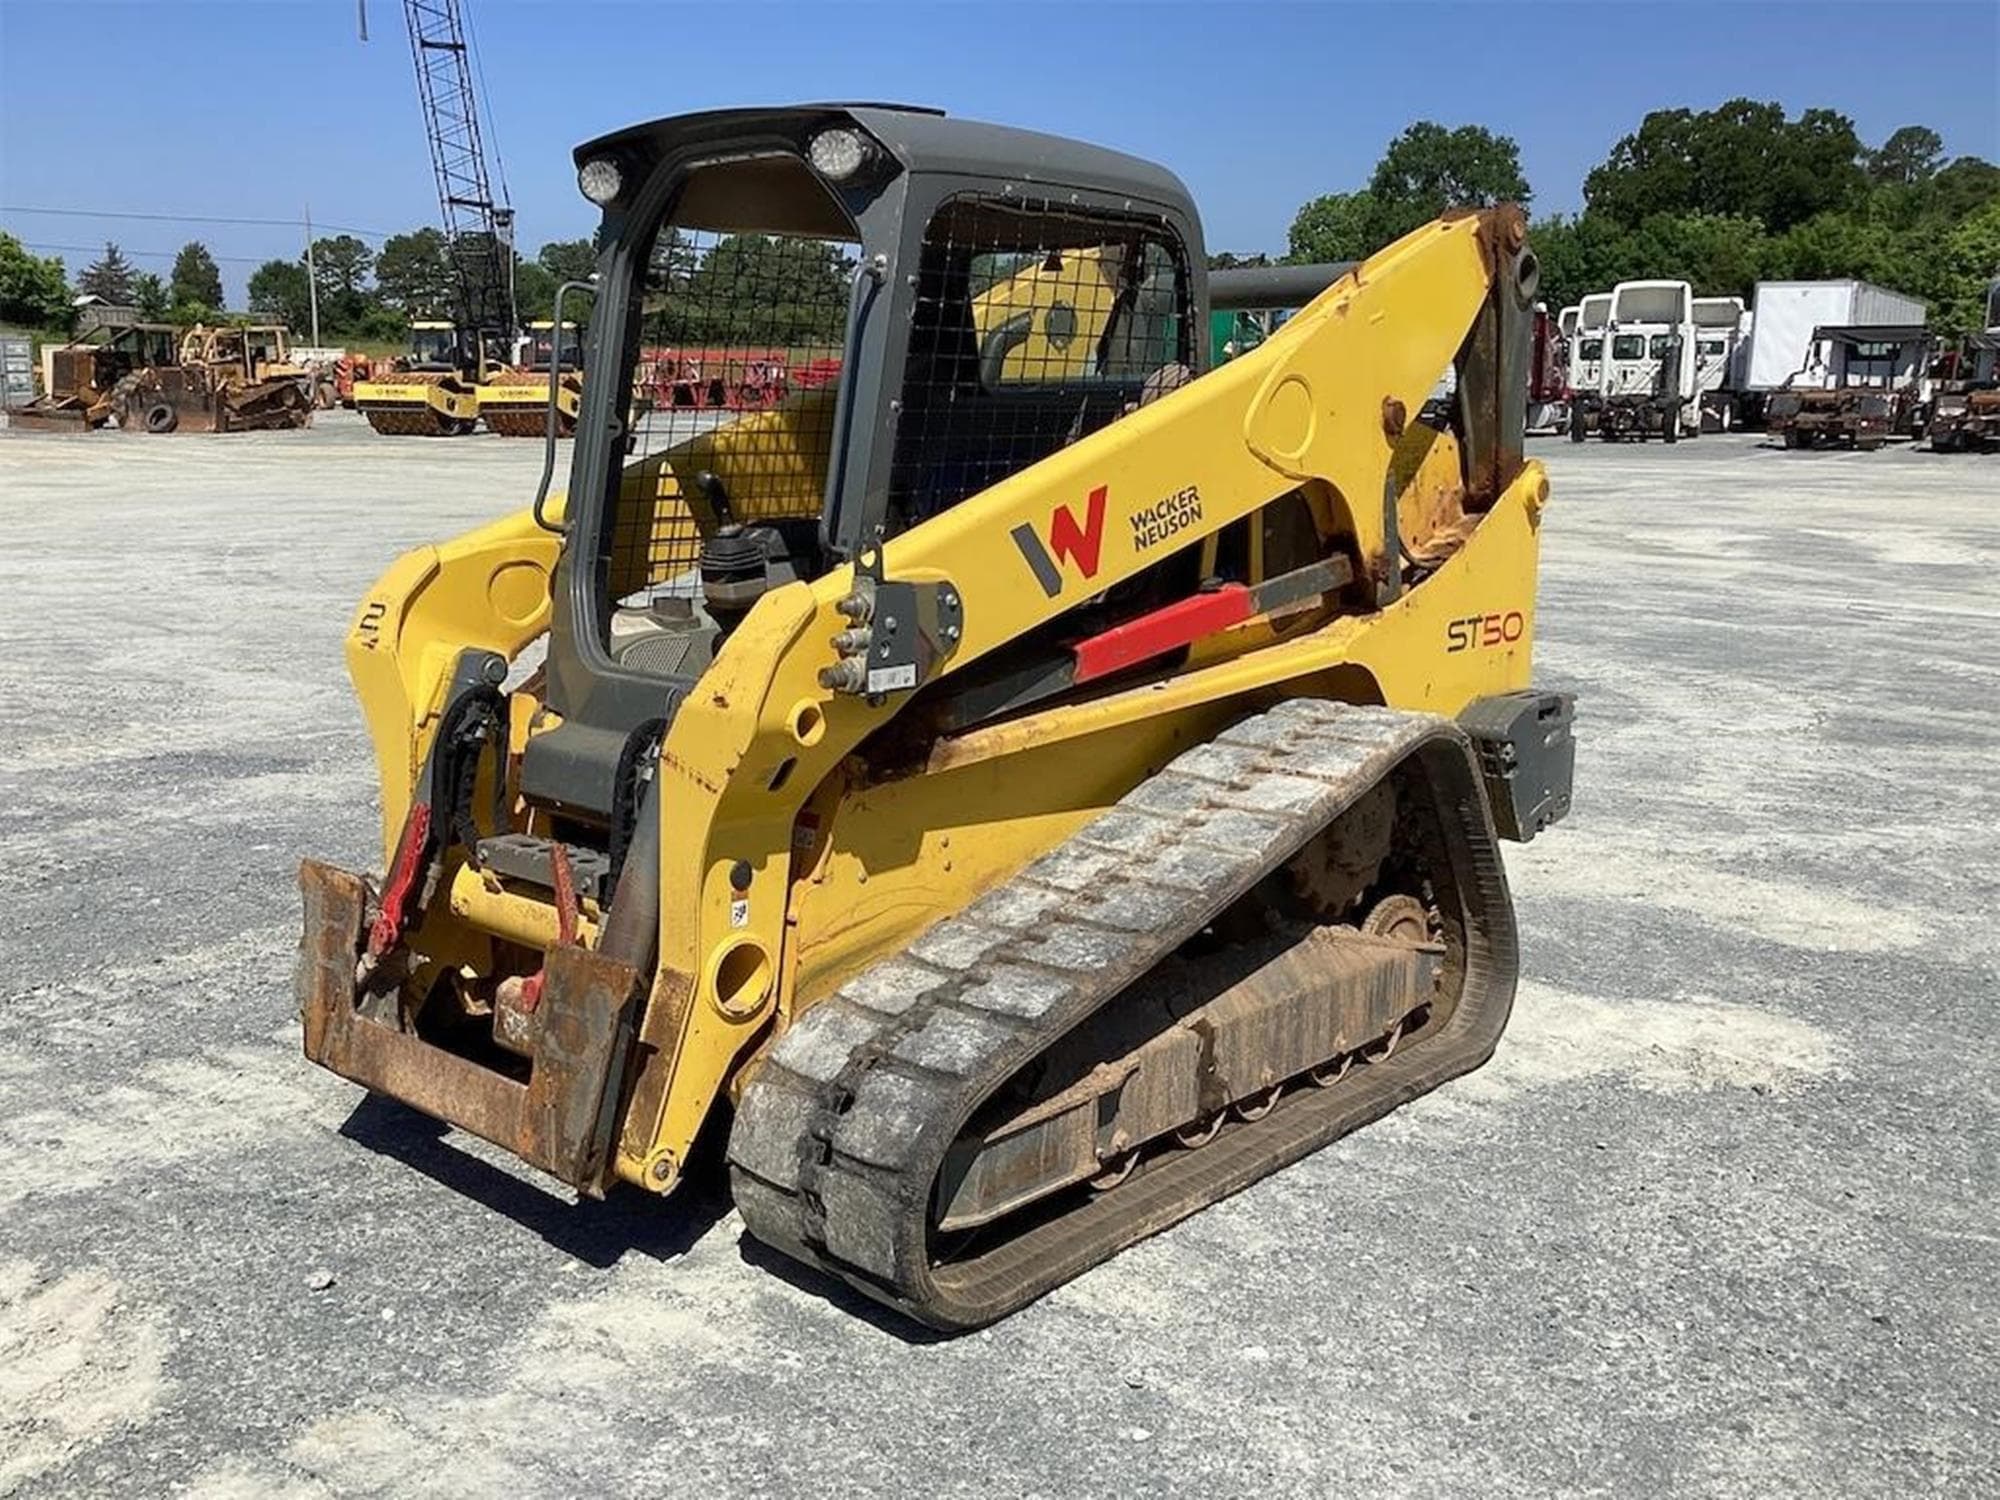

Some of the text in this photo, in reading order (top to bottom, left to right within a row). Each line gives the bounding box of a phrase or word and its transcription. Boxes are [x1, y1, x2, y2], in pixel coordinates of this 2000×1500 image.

[1130, 485, 1200, 533] WACKER
[1133, 503, 1202, 552] NEUSON
[1447, 611, 1524, 652] ST50
